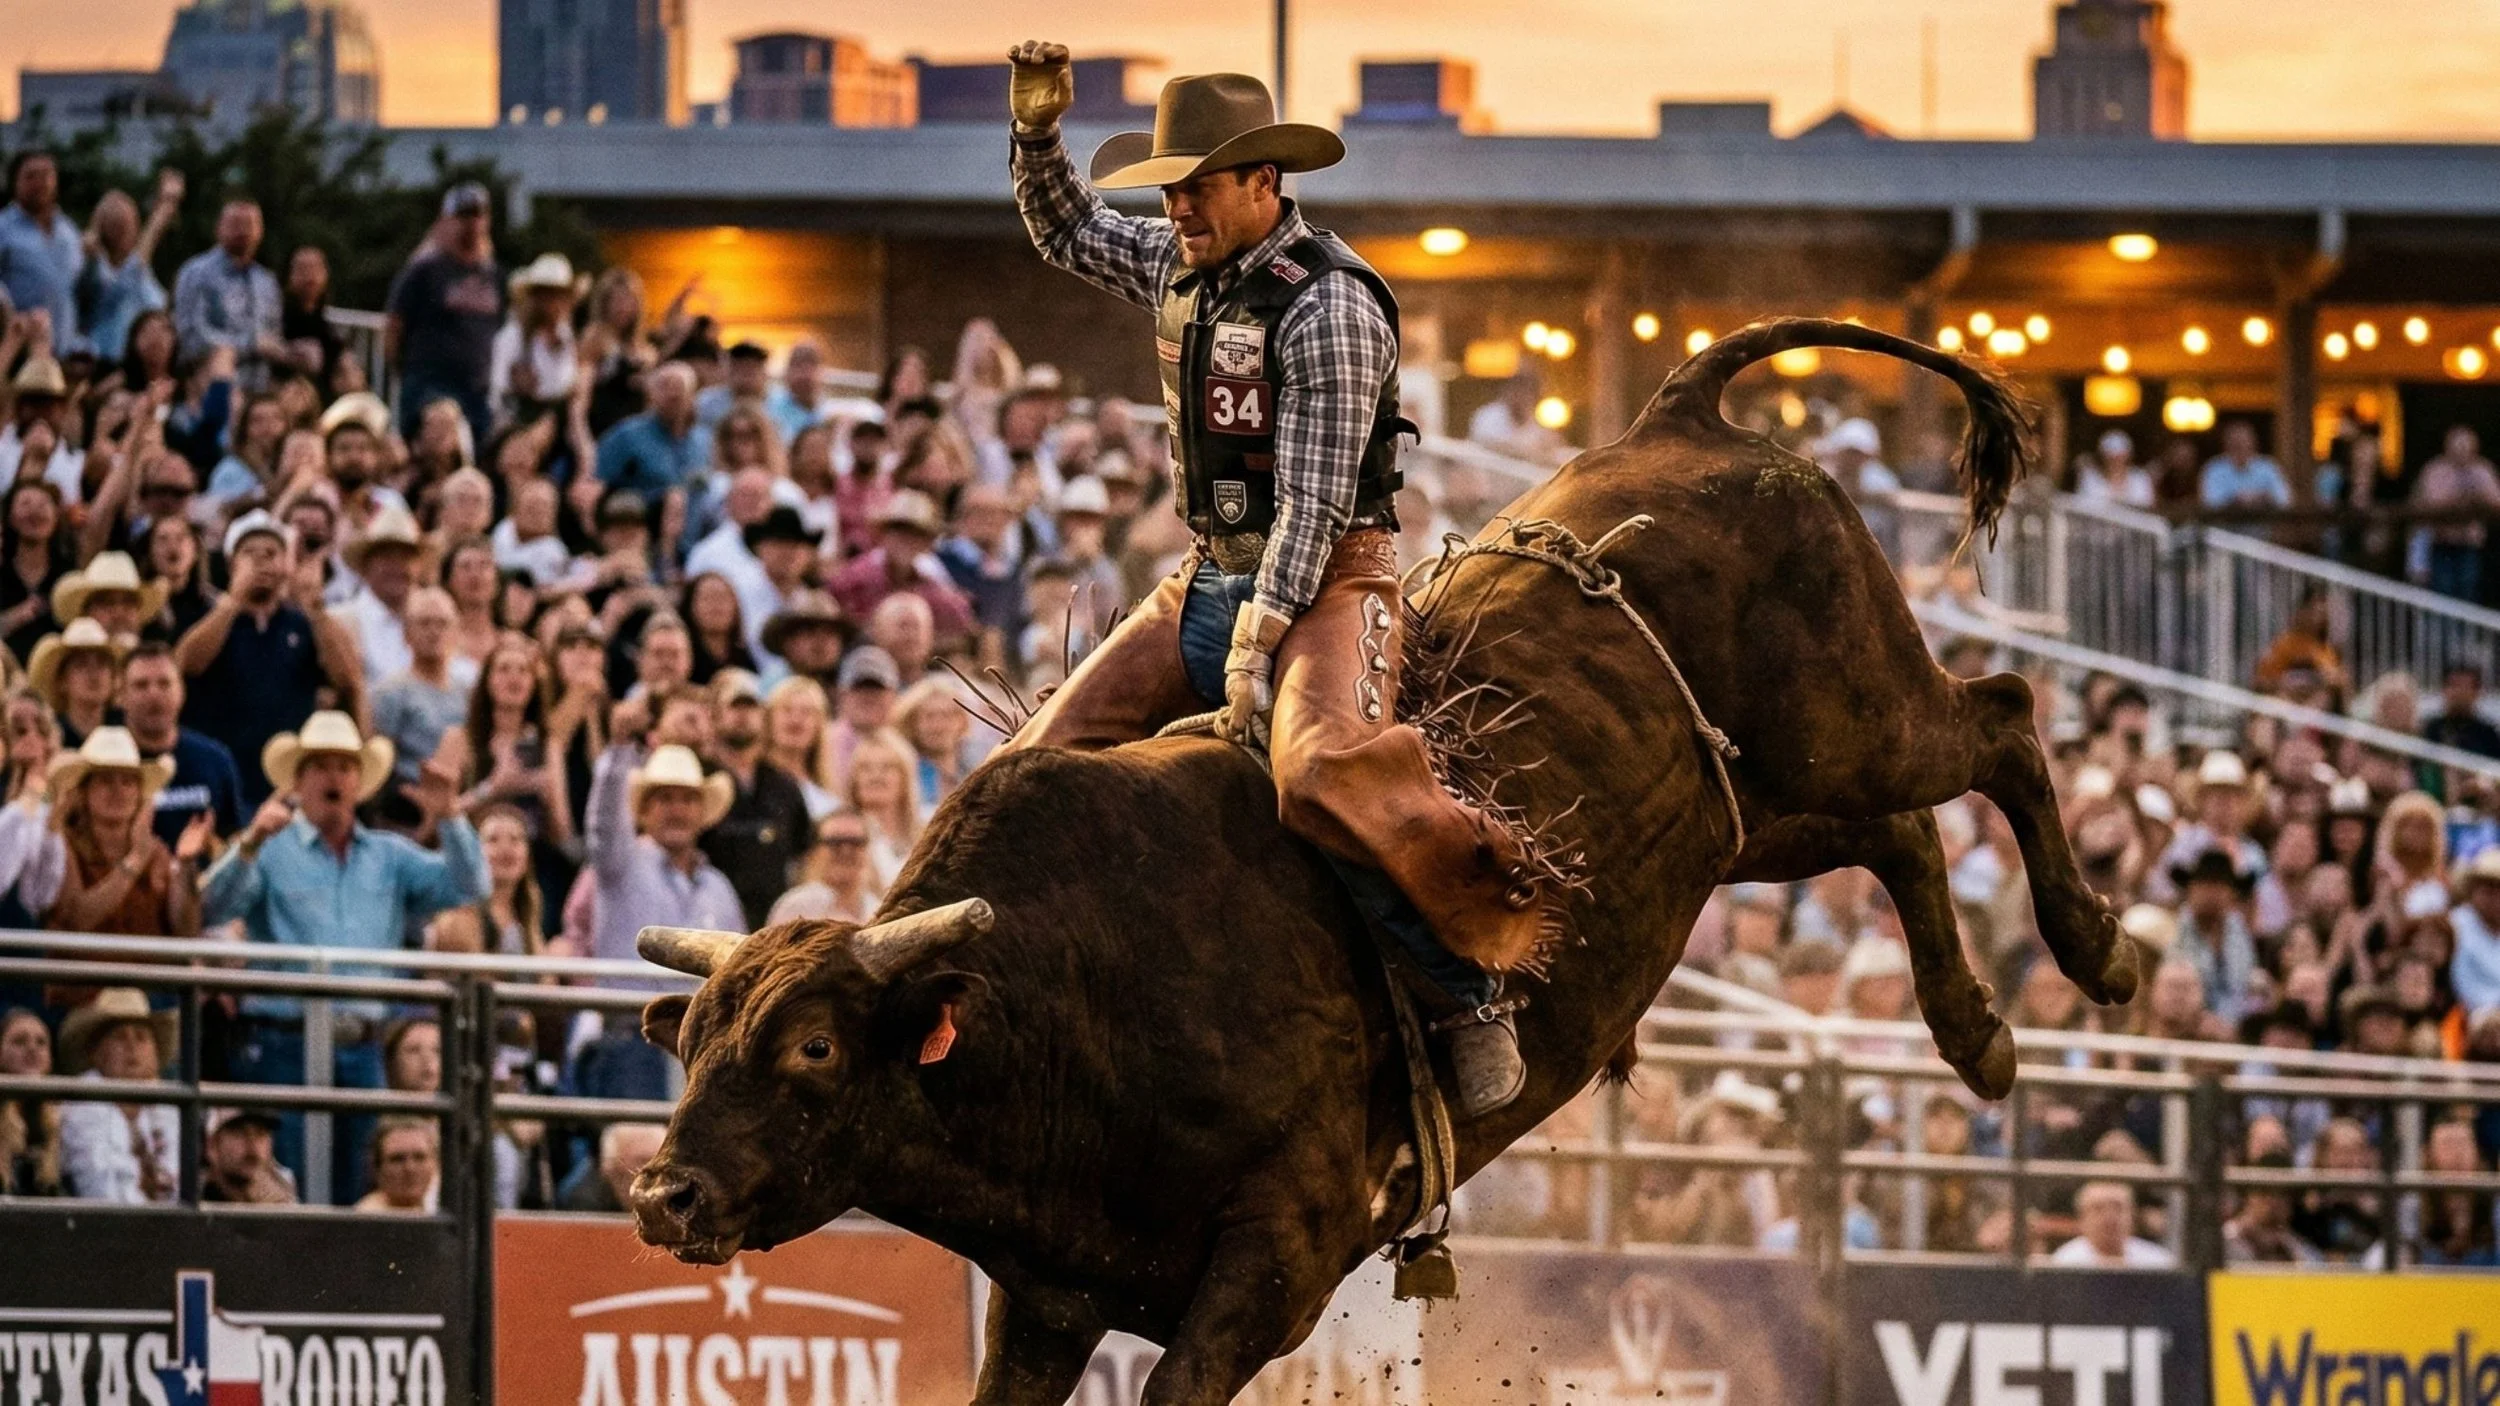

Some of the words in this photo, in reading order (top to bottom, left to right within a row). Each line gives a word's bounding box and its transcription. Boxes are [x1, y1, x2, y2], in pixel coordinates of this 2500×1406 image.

[1212, 385, 1263, 428] 34
[259, 1334, 446, 1406] RODEO
[577, 1331, 901, 1406] AUSTIN
[1872, 1319, 2163, 1406] YETI
